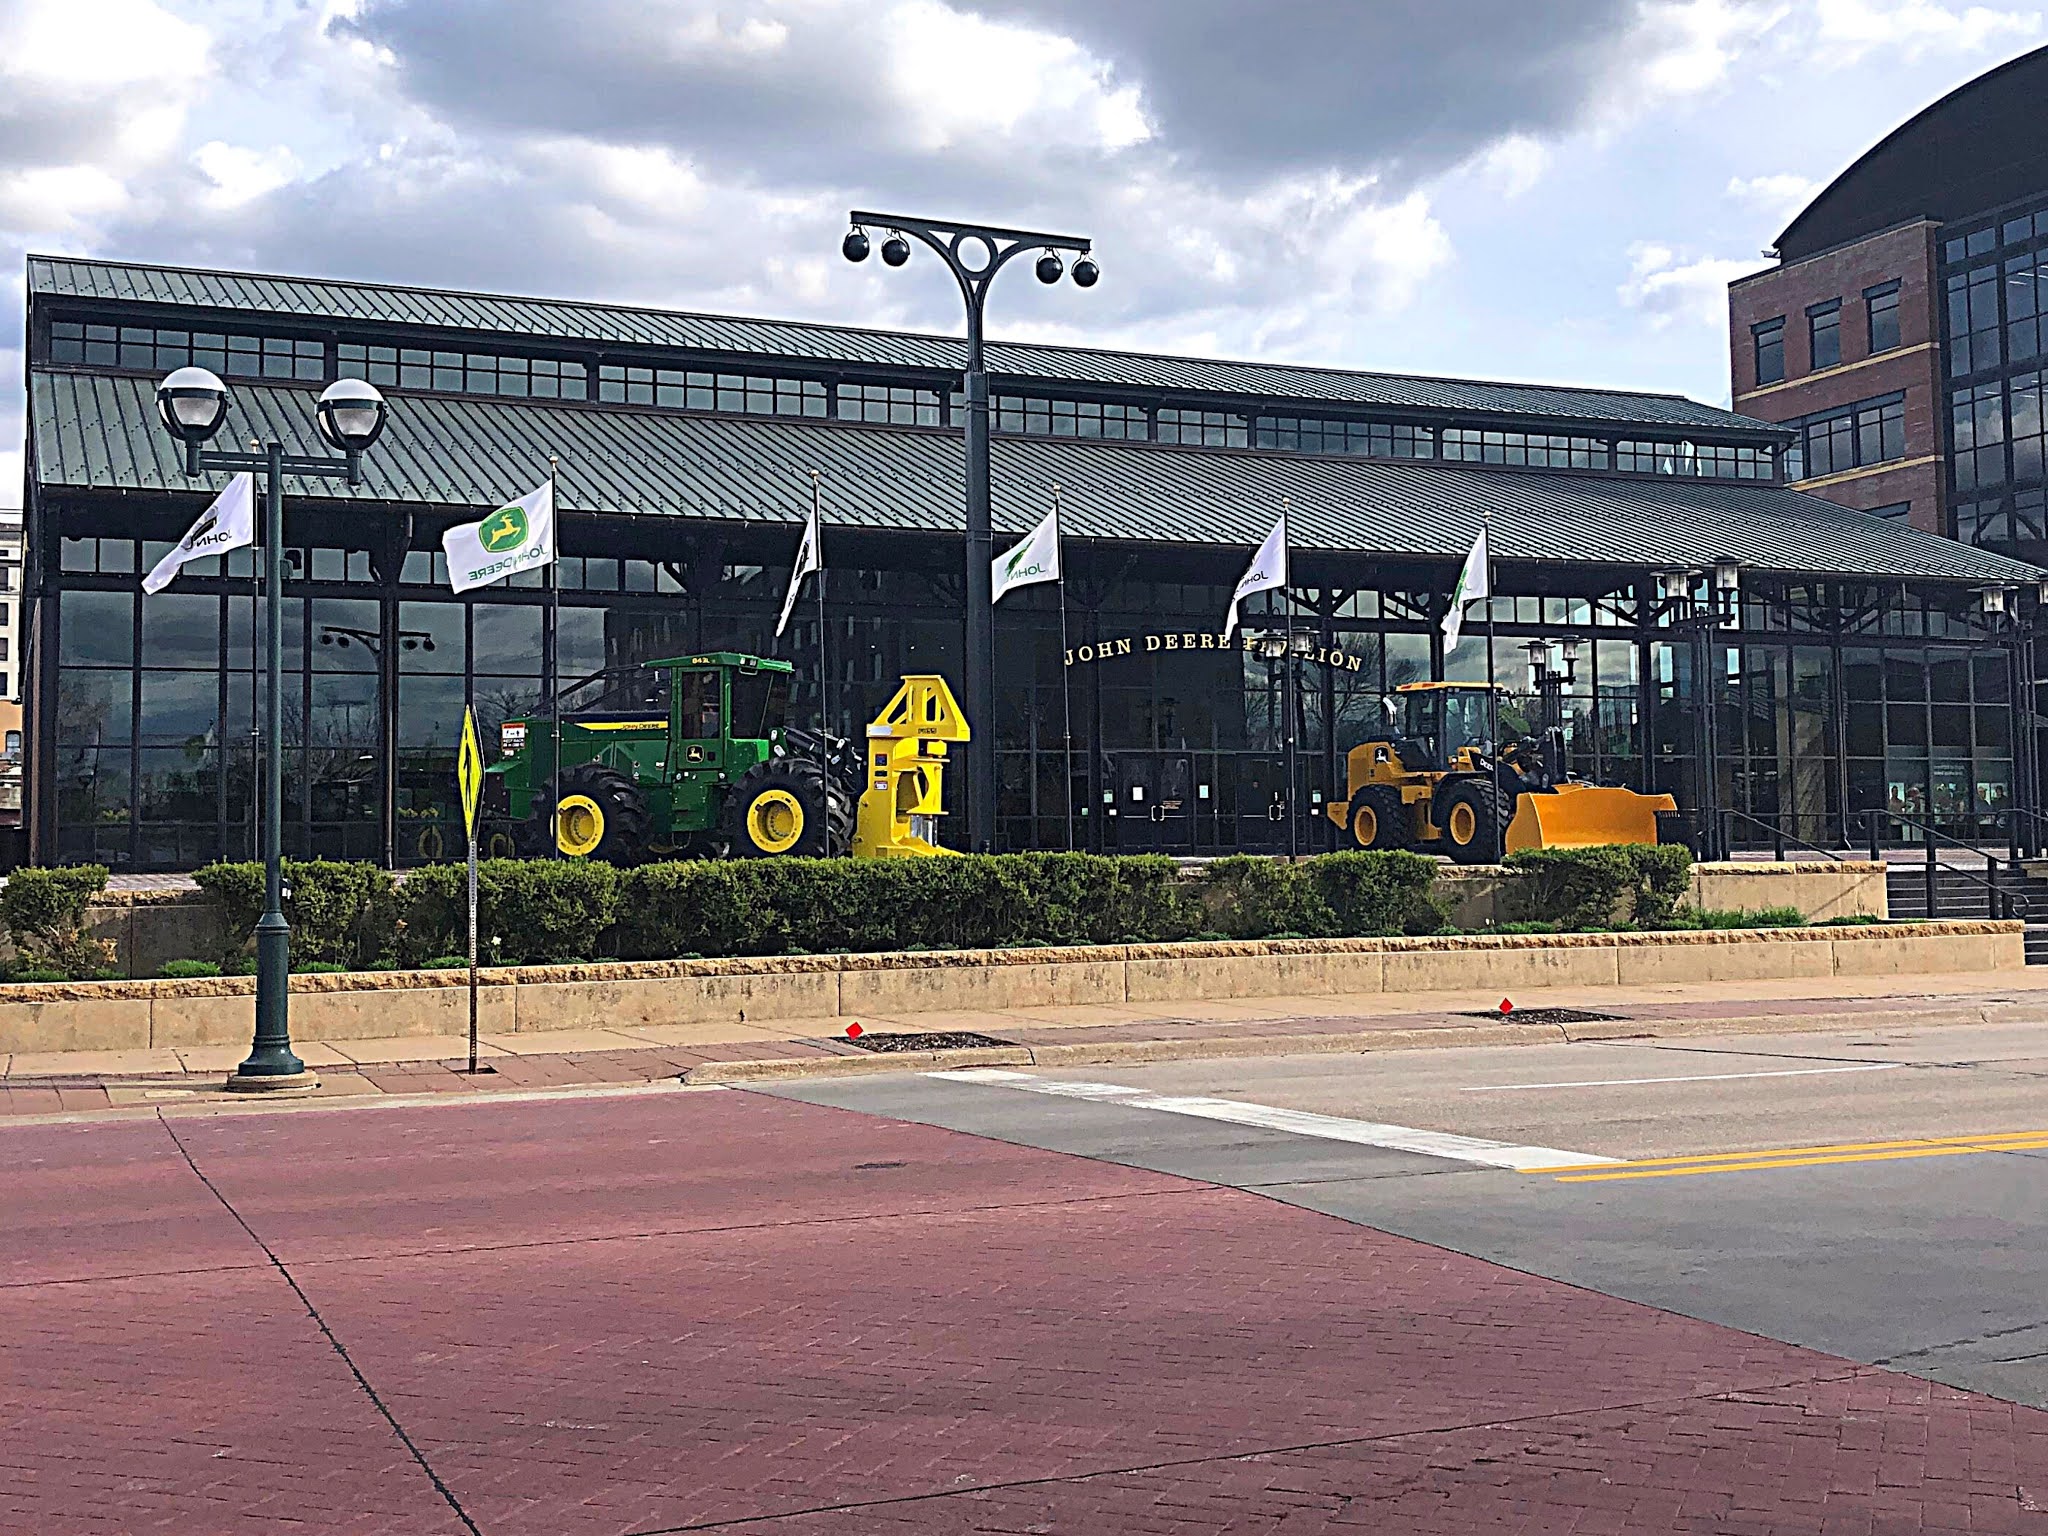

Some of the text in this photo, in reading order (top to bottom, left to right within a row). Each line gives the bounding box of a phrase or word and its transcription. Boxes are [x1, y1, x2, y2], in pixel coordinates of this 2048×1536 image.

[1065, 633, 1362, 672] JOHN DEERE PVLION
